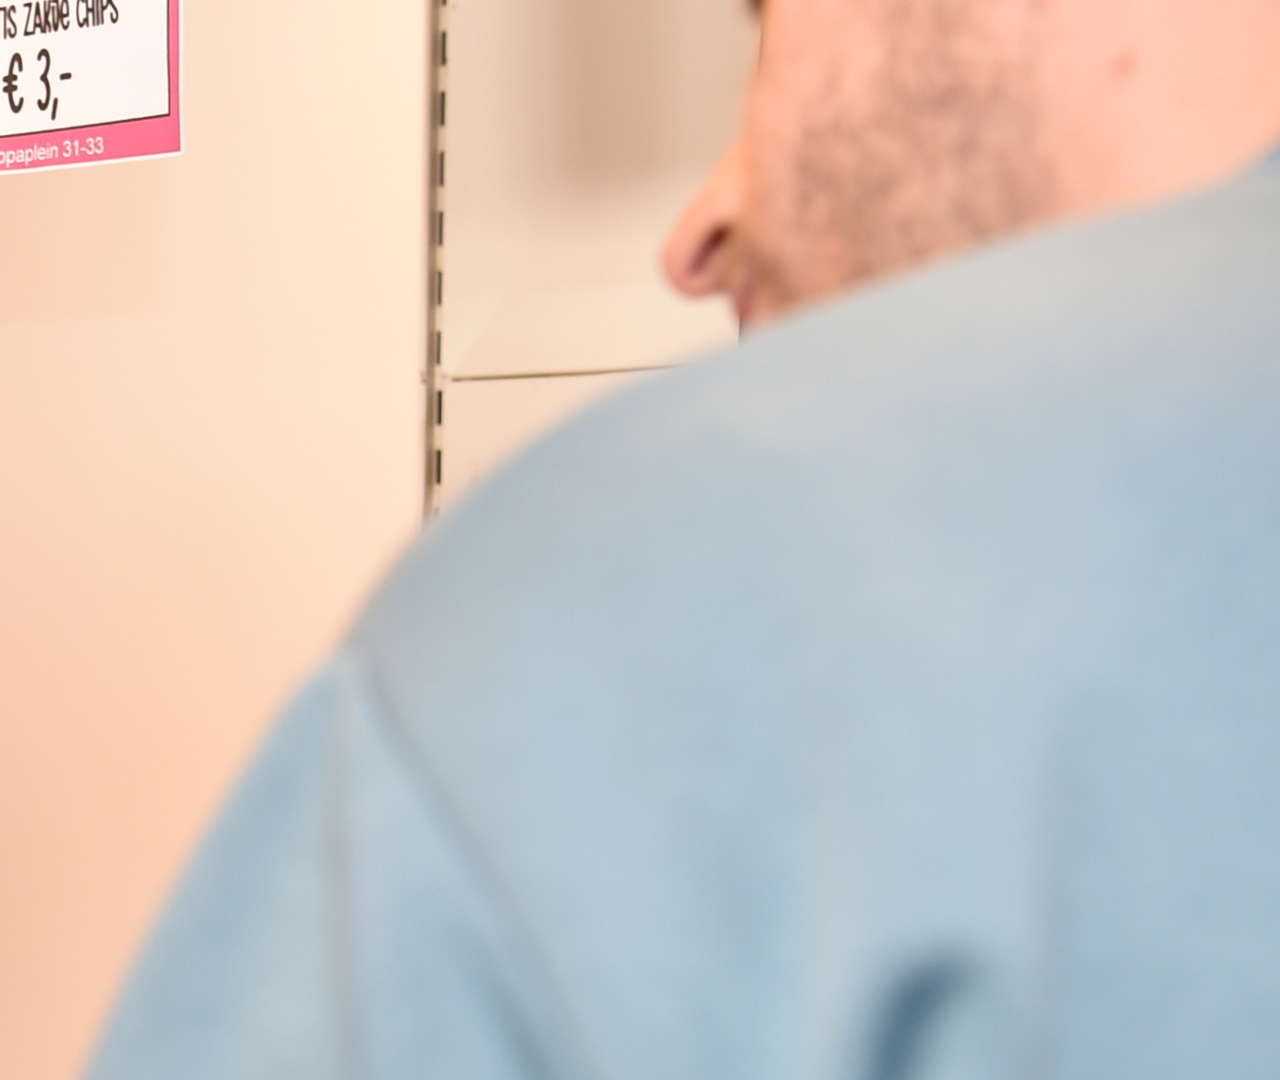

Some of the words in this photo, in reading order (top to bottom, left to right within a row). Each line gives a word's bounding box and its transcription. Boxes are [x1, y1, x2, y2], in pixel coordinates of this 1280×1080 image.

[75, 0, 119, 28] CHIPS
[2, 52, 24, 113] €
[37, 48, 72, 120] 3,-
[62, 136, 105, 158] 31-33
